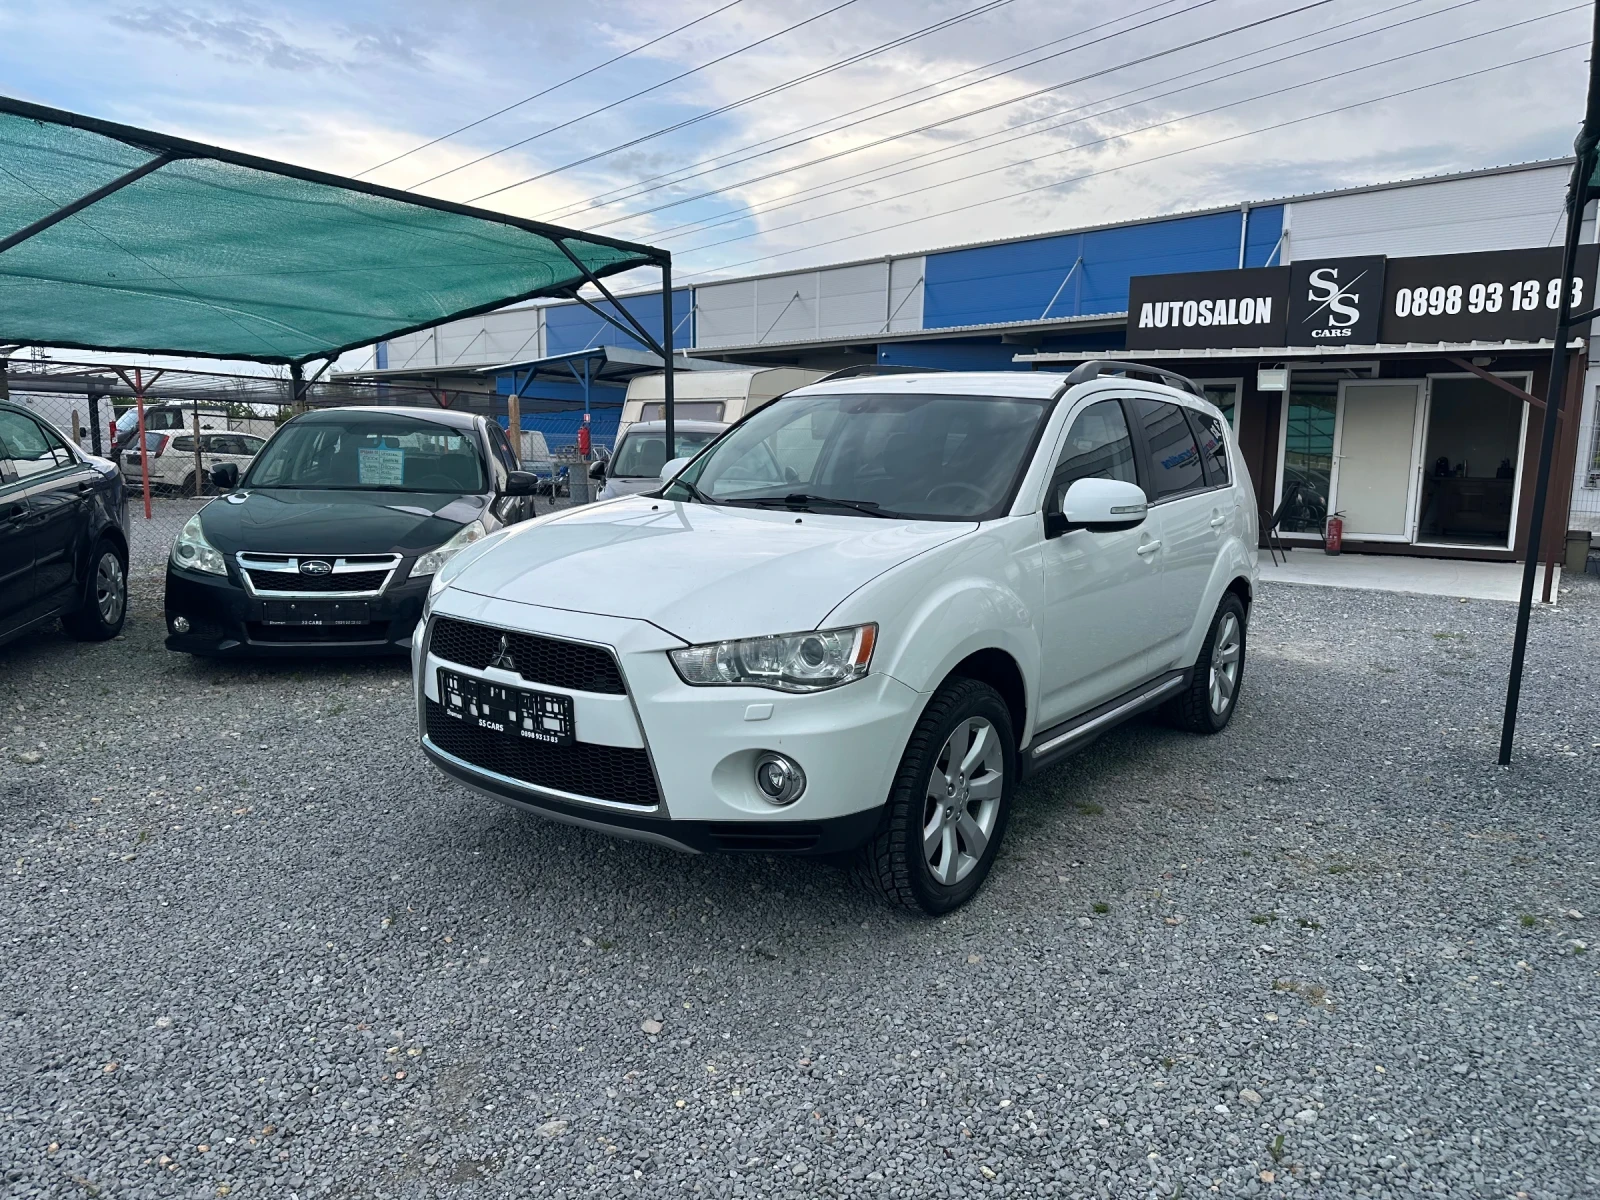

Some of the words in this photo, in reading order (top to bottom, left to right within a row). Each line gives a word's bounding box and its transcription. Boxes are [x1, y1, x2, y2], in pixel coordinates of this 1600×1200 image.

[1395, 286, 1463, 317] 0898
[1468, 282, 1504, 313] 93
[1509, 280, 1540, 311] 13
[1138, 297, 1272, 328] AUTOSALON
[1311, 328, 1352, 338] CARS
[478, 718, 487, 728] SS
[486, 721, 504, 732] CARS
[543, 734, 550, 742] 13
